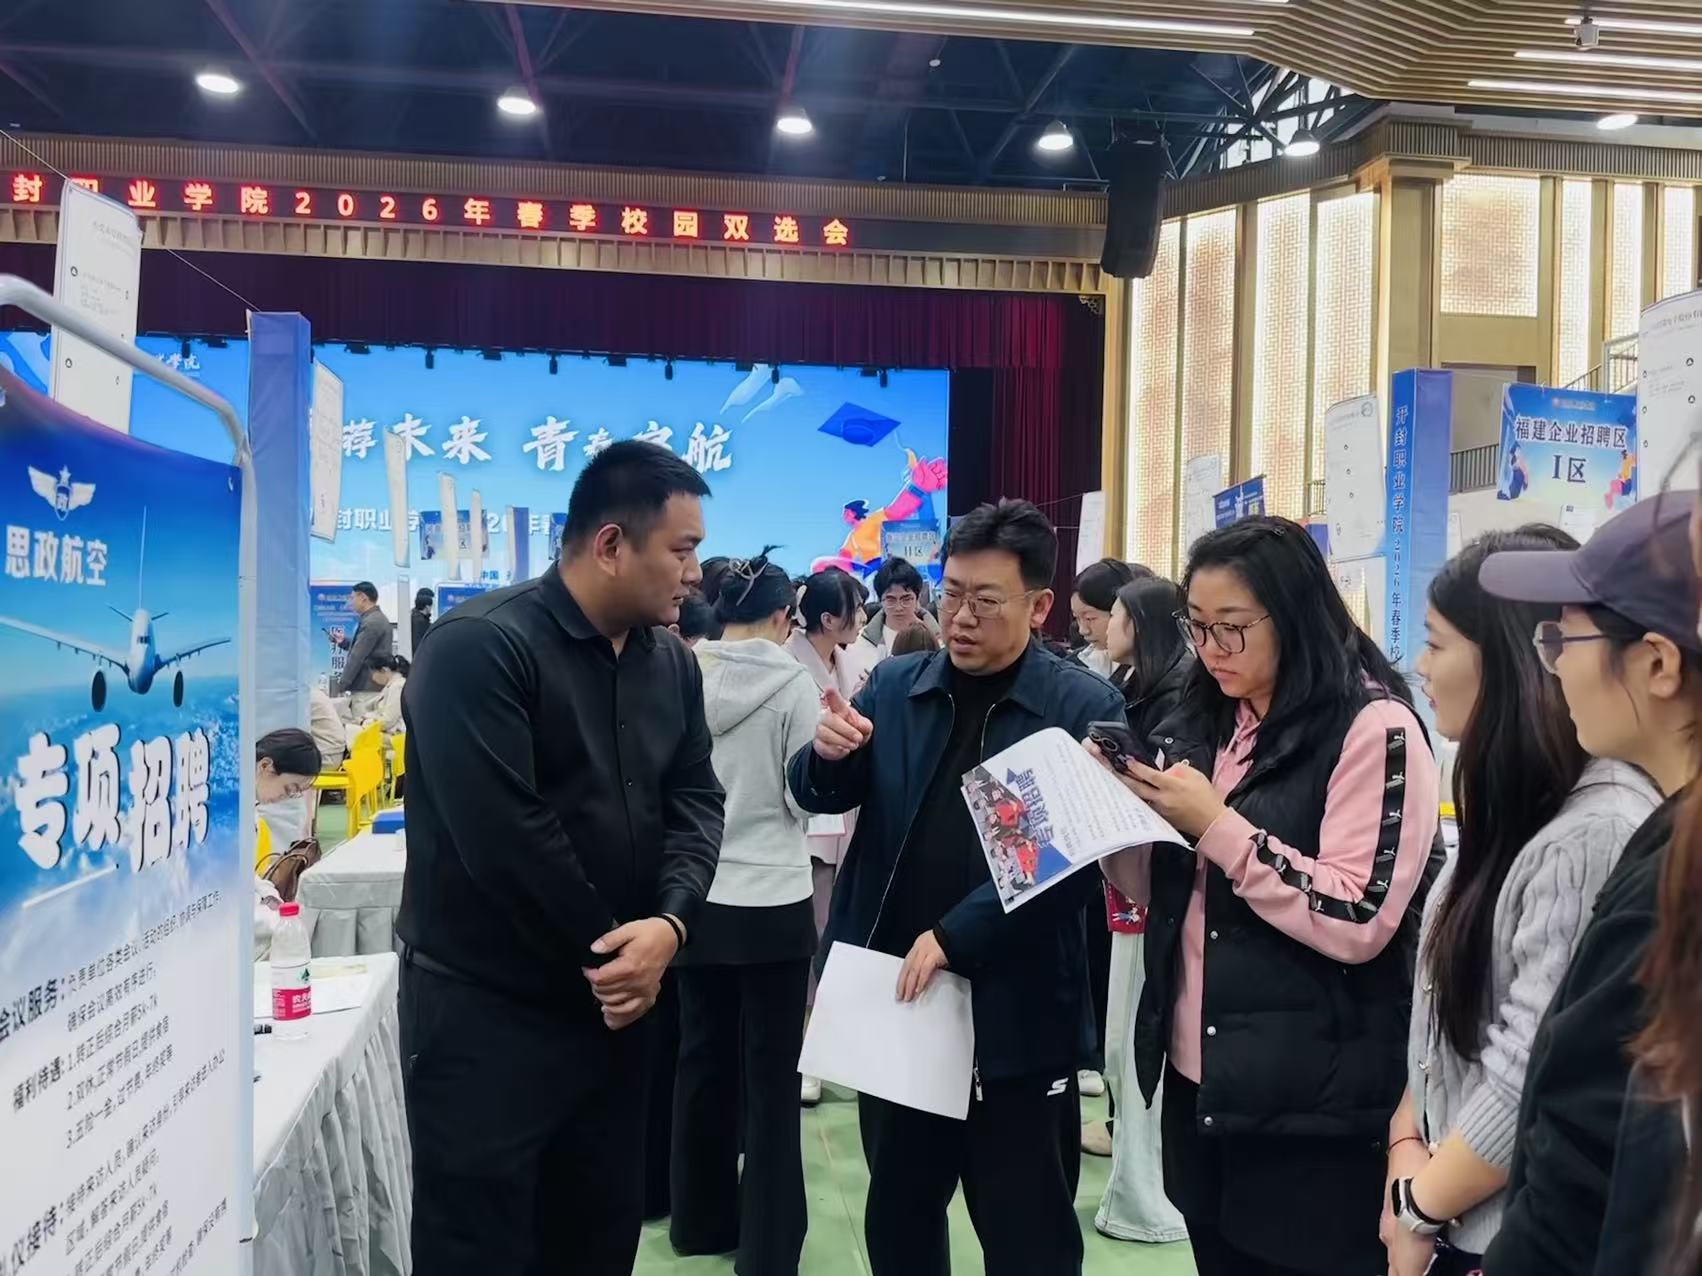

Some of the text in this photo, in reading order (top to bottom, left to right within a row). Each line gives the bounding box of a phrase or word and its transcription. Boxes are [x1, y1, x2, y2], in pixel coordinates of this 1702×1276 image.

[12, 173, 849, 246] 封业学院2026年春季校园双选会
[1515, 417, 1627, 449] 福建企业招聘区
[1552, 453, 1587, 484] I区
[4, 524, 108, 587] 思政航空
[15, 721, 211, 873] 专项招聘
